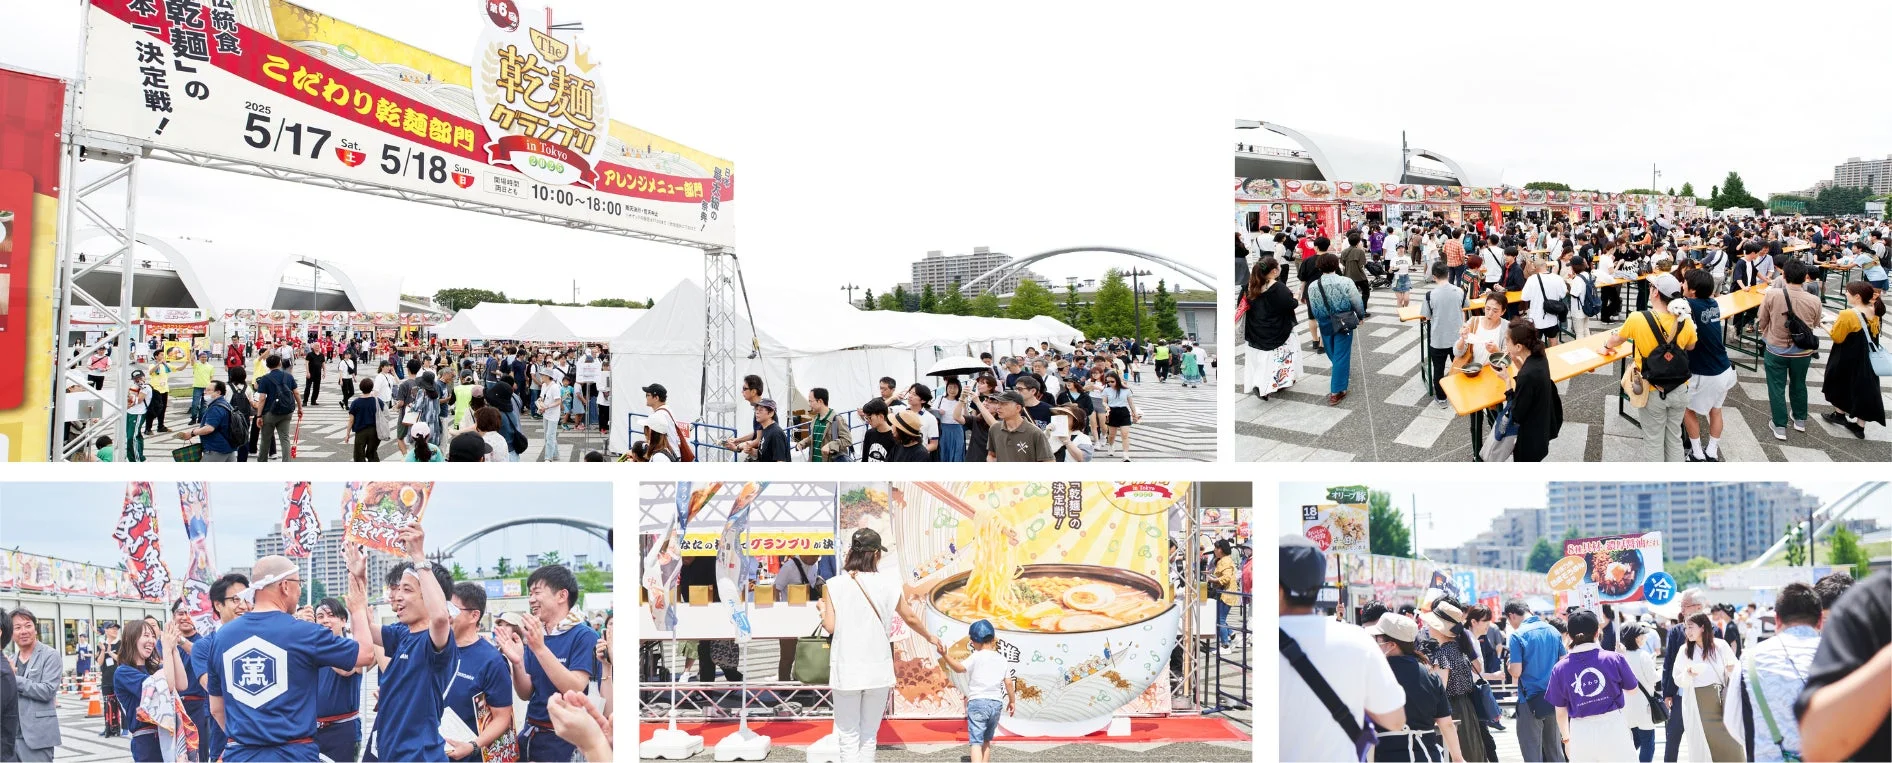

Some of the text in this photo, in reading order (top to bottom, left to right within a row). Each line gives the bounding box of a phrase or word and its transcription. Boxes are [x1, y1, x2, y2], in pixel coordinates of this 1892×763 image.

[537, 35, 562, 59] The
[496, 45, 598, 132] 乾麺
[244, 101, 272, 115] 2025
[262, 54, 475, 152] こだわり乾麺部門
[243, 113, 332, 159] 5/17
[489, 103, 597, 155] グランプリ
[340, 138, 361, 151] Sat.
[526, 140, 568, 161] in Tokyo
[380, 143, 447, 184] 5/18
[454, 163, 473, 175] Sun.
[528, 155, 565, 173] 2025
[603, 168, 704, 199] アレンジメニュー部門
[1303, 507, 1318, 517] 18
[1648, 577, 1672, 601] 冷
